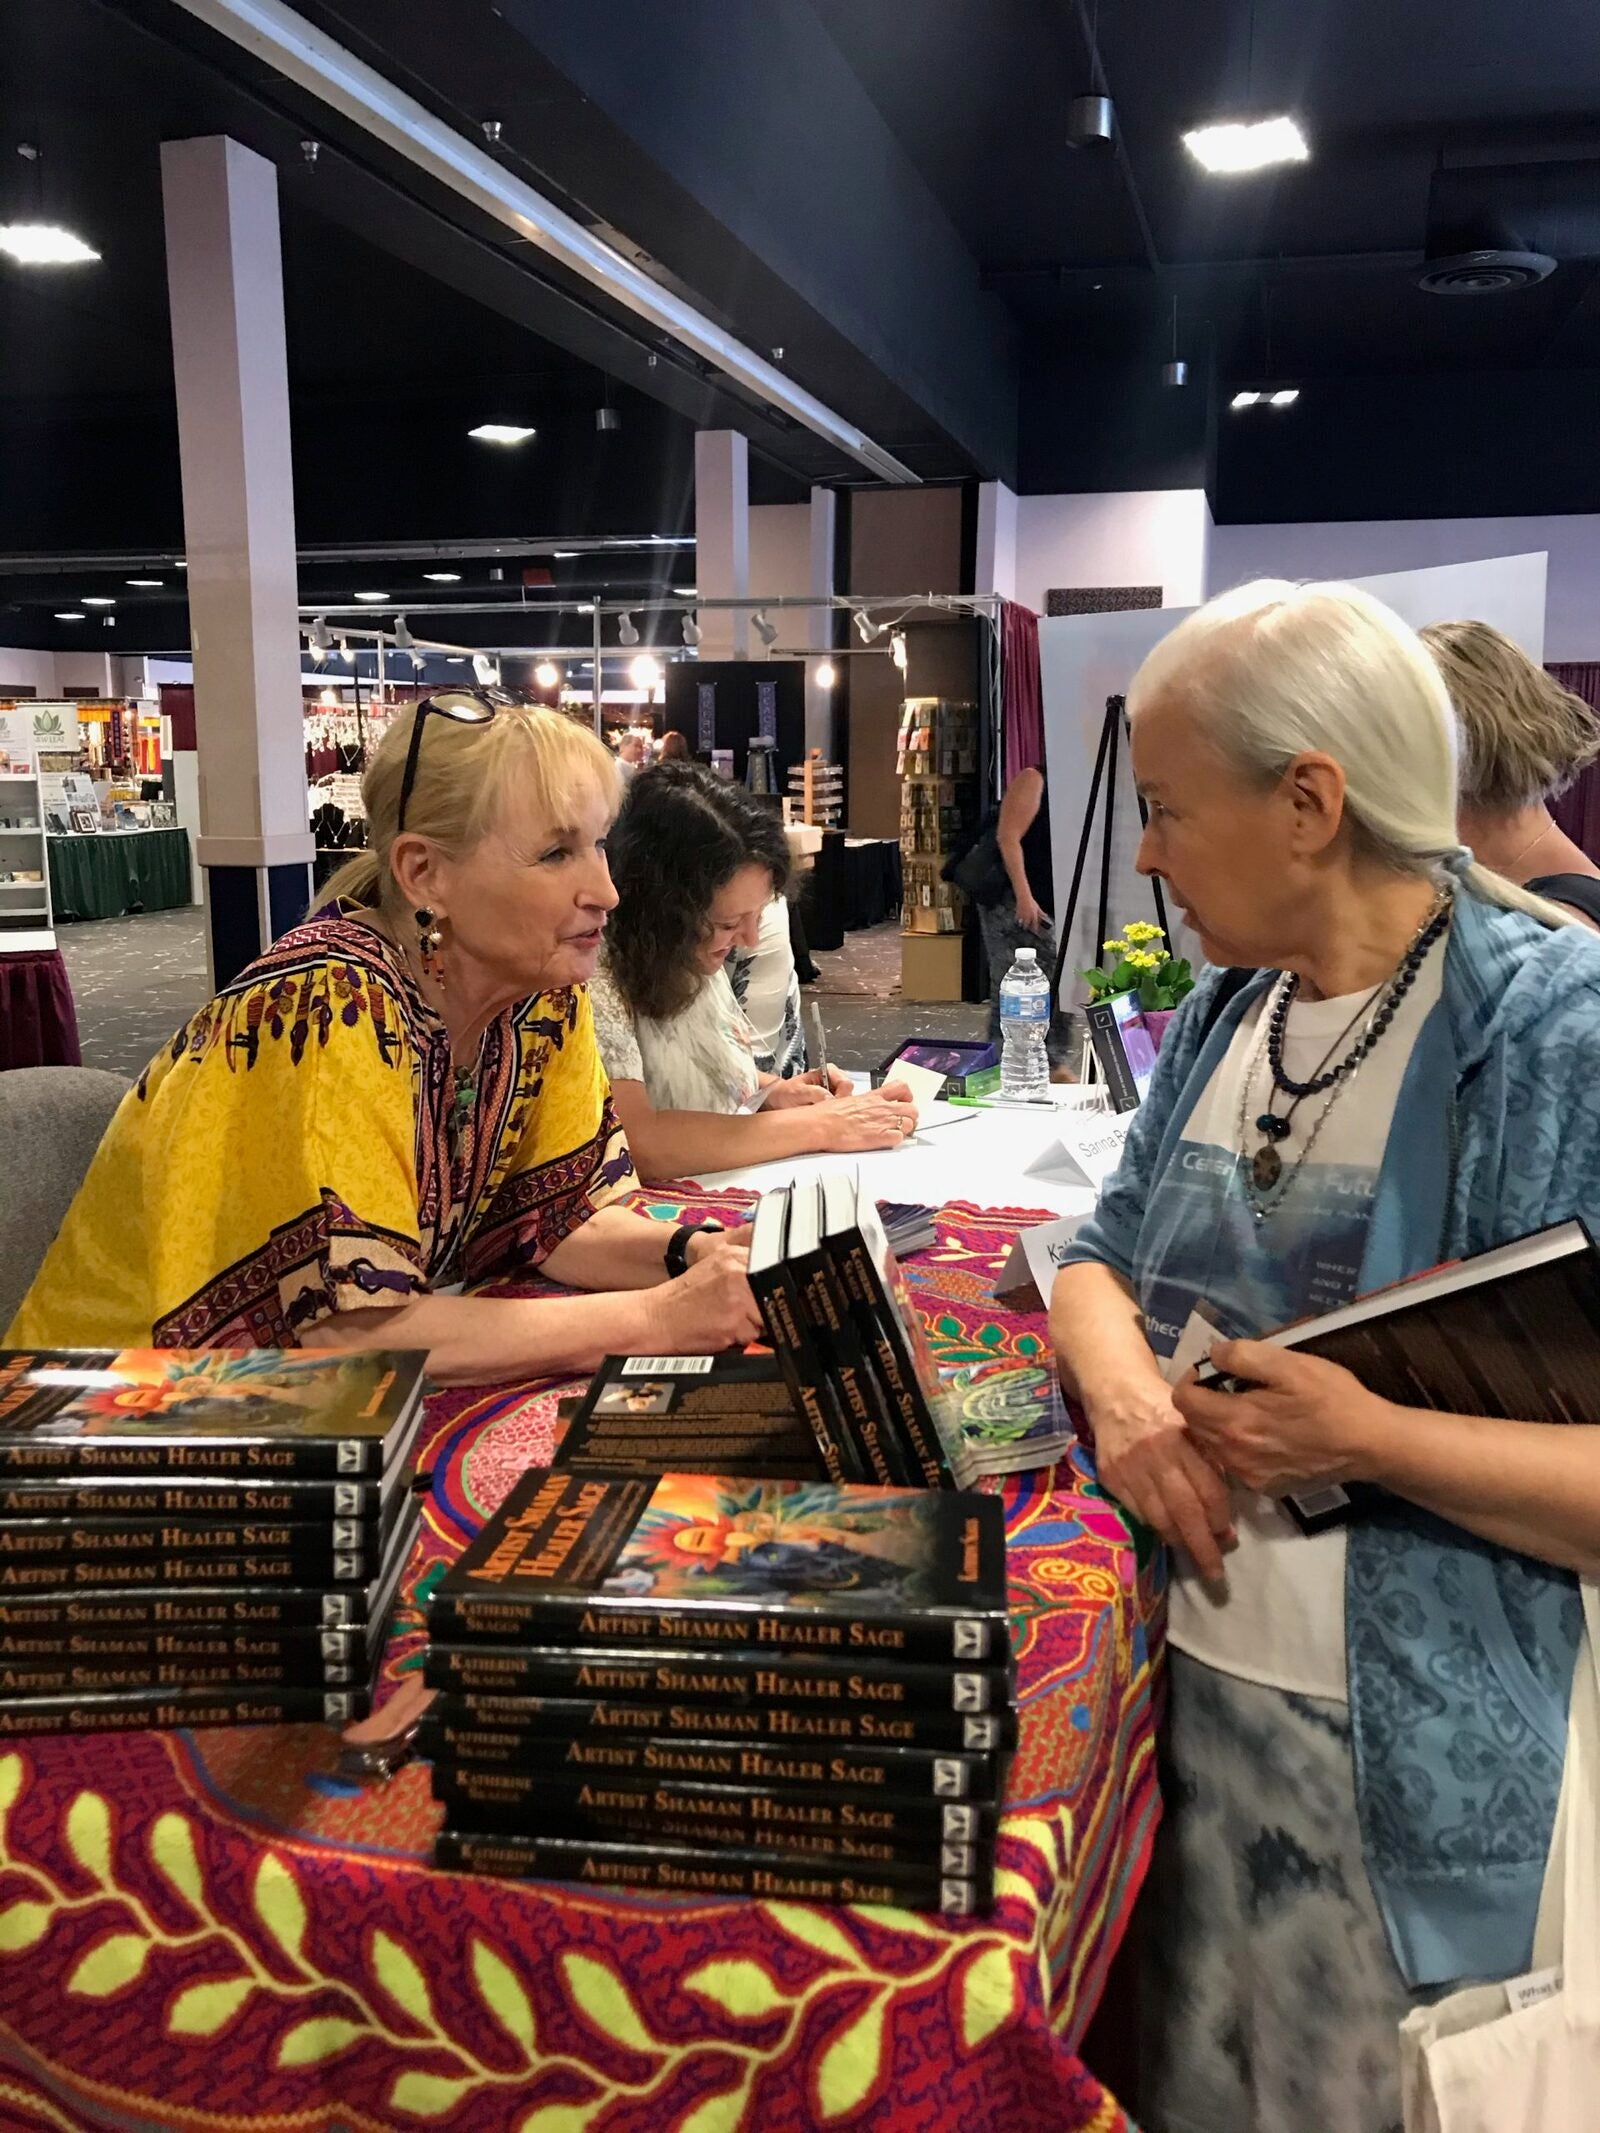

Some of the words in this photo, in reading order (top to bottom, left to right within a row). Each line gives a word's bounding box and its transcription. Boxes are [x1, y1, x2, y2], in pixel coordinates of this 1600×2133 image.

[1316, 1261, 1358, 1275] WHER
[838, 1366, 867, 1419] ARTIST
[799, 1386, 831, 1444] ARTIST
[897, 1392, 930, 1458] SHAMAN
[7, 1448, 73, 1465] ARTIST
[79, 1447, 160, 1465] SHAMAN
[167, 1447, 241, 1465] HEALER
[247, 1447, 296, 1466] SAGE
[4, 1491, 71, 1509] ARTIST
[76, 1489, 158, 1509] SHAMAN
[165, 1490, 238, 1509] HEALER
[245, 1490, 293, 1510] SAGE
[0, 1532, 66, 1550] ARTIST
[72, 1530, 155, 1549] SHAMAN
[161, 1528, 236, 1546] HEALER
[243, 1527, 291, 1545] SAGE
[2, 1566, 68, 1585] ARTIST
[75, 1563, 157, 1583] SHAMAN
[164, 1560, 238, 1579] HEALER
[244, 1558, 292, 1576] SAGE
[0, 1606, 60, 1623] ARTIST
[66, 1603, 147, 1621] SHAMAN
[154, 1602, 228, 1620] HEALER
[234, 1602, 281, 1619] SAGE
[455, 1599, 533, 1618] KATHERINE
[579, 1611, 650, 1634] ARTIST
[658, 1614, 748, 1639] SHAMAN
[758, 1618, 842, 1645] HEALER
[849, 1622, 905, 1648] SAGE
[2, 1636, 64, 1652] ARTIST
[70, 1635, 149, 1652] SHAMAN
[156, 1636, 229, 1654] HEALER
[234, 1636, 281, 1654] SAGE
[3, 1670, 66, 1687] ARTIST
[72, 1667, 151, 1686] SHAMAN
[158, 1664, 231, 1682] HEALER
[237, 1663, 284, 1680] SAGE
[577, 1665, 649, 1688] ARTIST
[656, 1667, 747, 1693] SHAMAN
[756, 1671, 841, 1698] HEALER
[848, 1675, 904, 1701] SAGE
[0, 1714, 63, 1730] ARTIST
[70, 1710, 149, 1728] SHAMAN
[156, 1706, 230, 1724] HEALER
[236, 1702, 284, 1720] SAGE
[590, 1701, 662, 1727] ARTIST
[670, 1706, 759, 1731] SHAMAN
[768, 1710, 851, 1736] HEALER
[859, 1714, 915, 1739] SAGE
[566, 1741, 637, 1766] ARTIST
[644, 1746, 731, 1773] SHAMAN
[741, 1752, 823, 1780] HEALER
[830, 1758, 886, 1784] SAGE
[579, 1784, 648, 1808] ARTIST
[654, 1790, 742, 1816] SHAMAN
[751, 1798, 832, 1824] HEALER
[841, 1804, 894, 1829] SAGE
[841, 1837, 894, 1861] SAGE
[583, 1856, 651, 1881] ARTIST
[658, 1863, 743, 1890] SHAMAN
[753, 1870, 833, 1897] HEALER
[841, 1877, 894, 1902] SAGE
